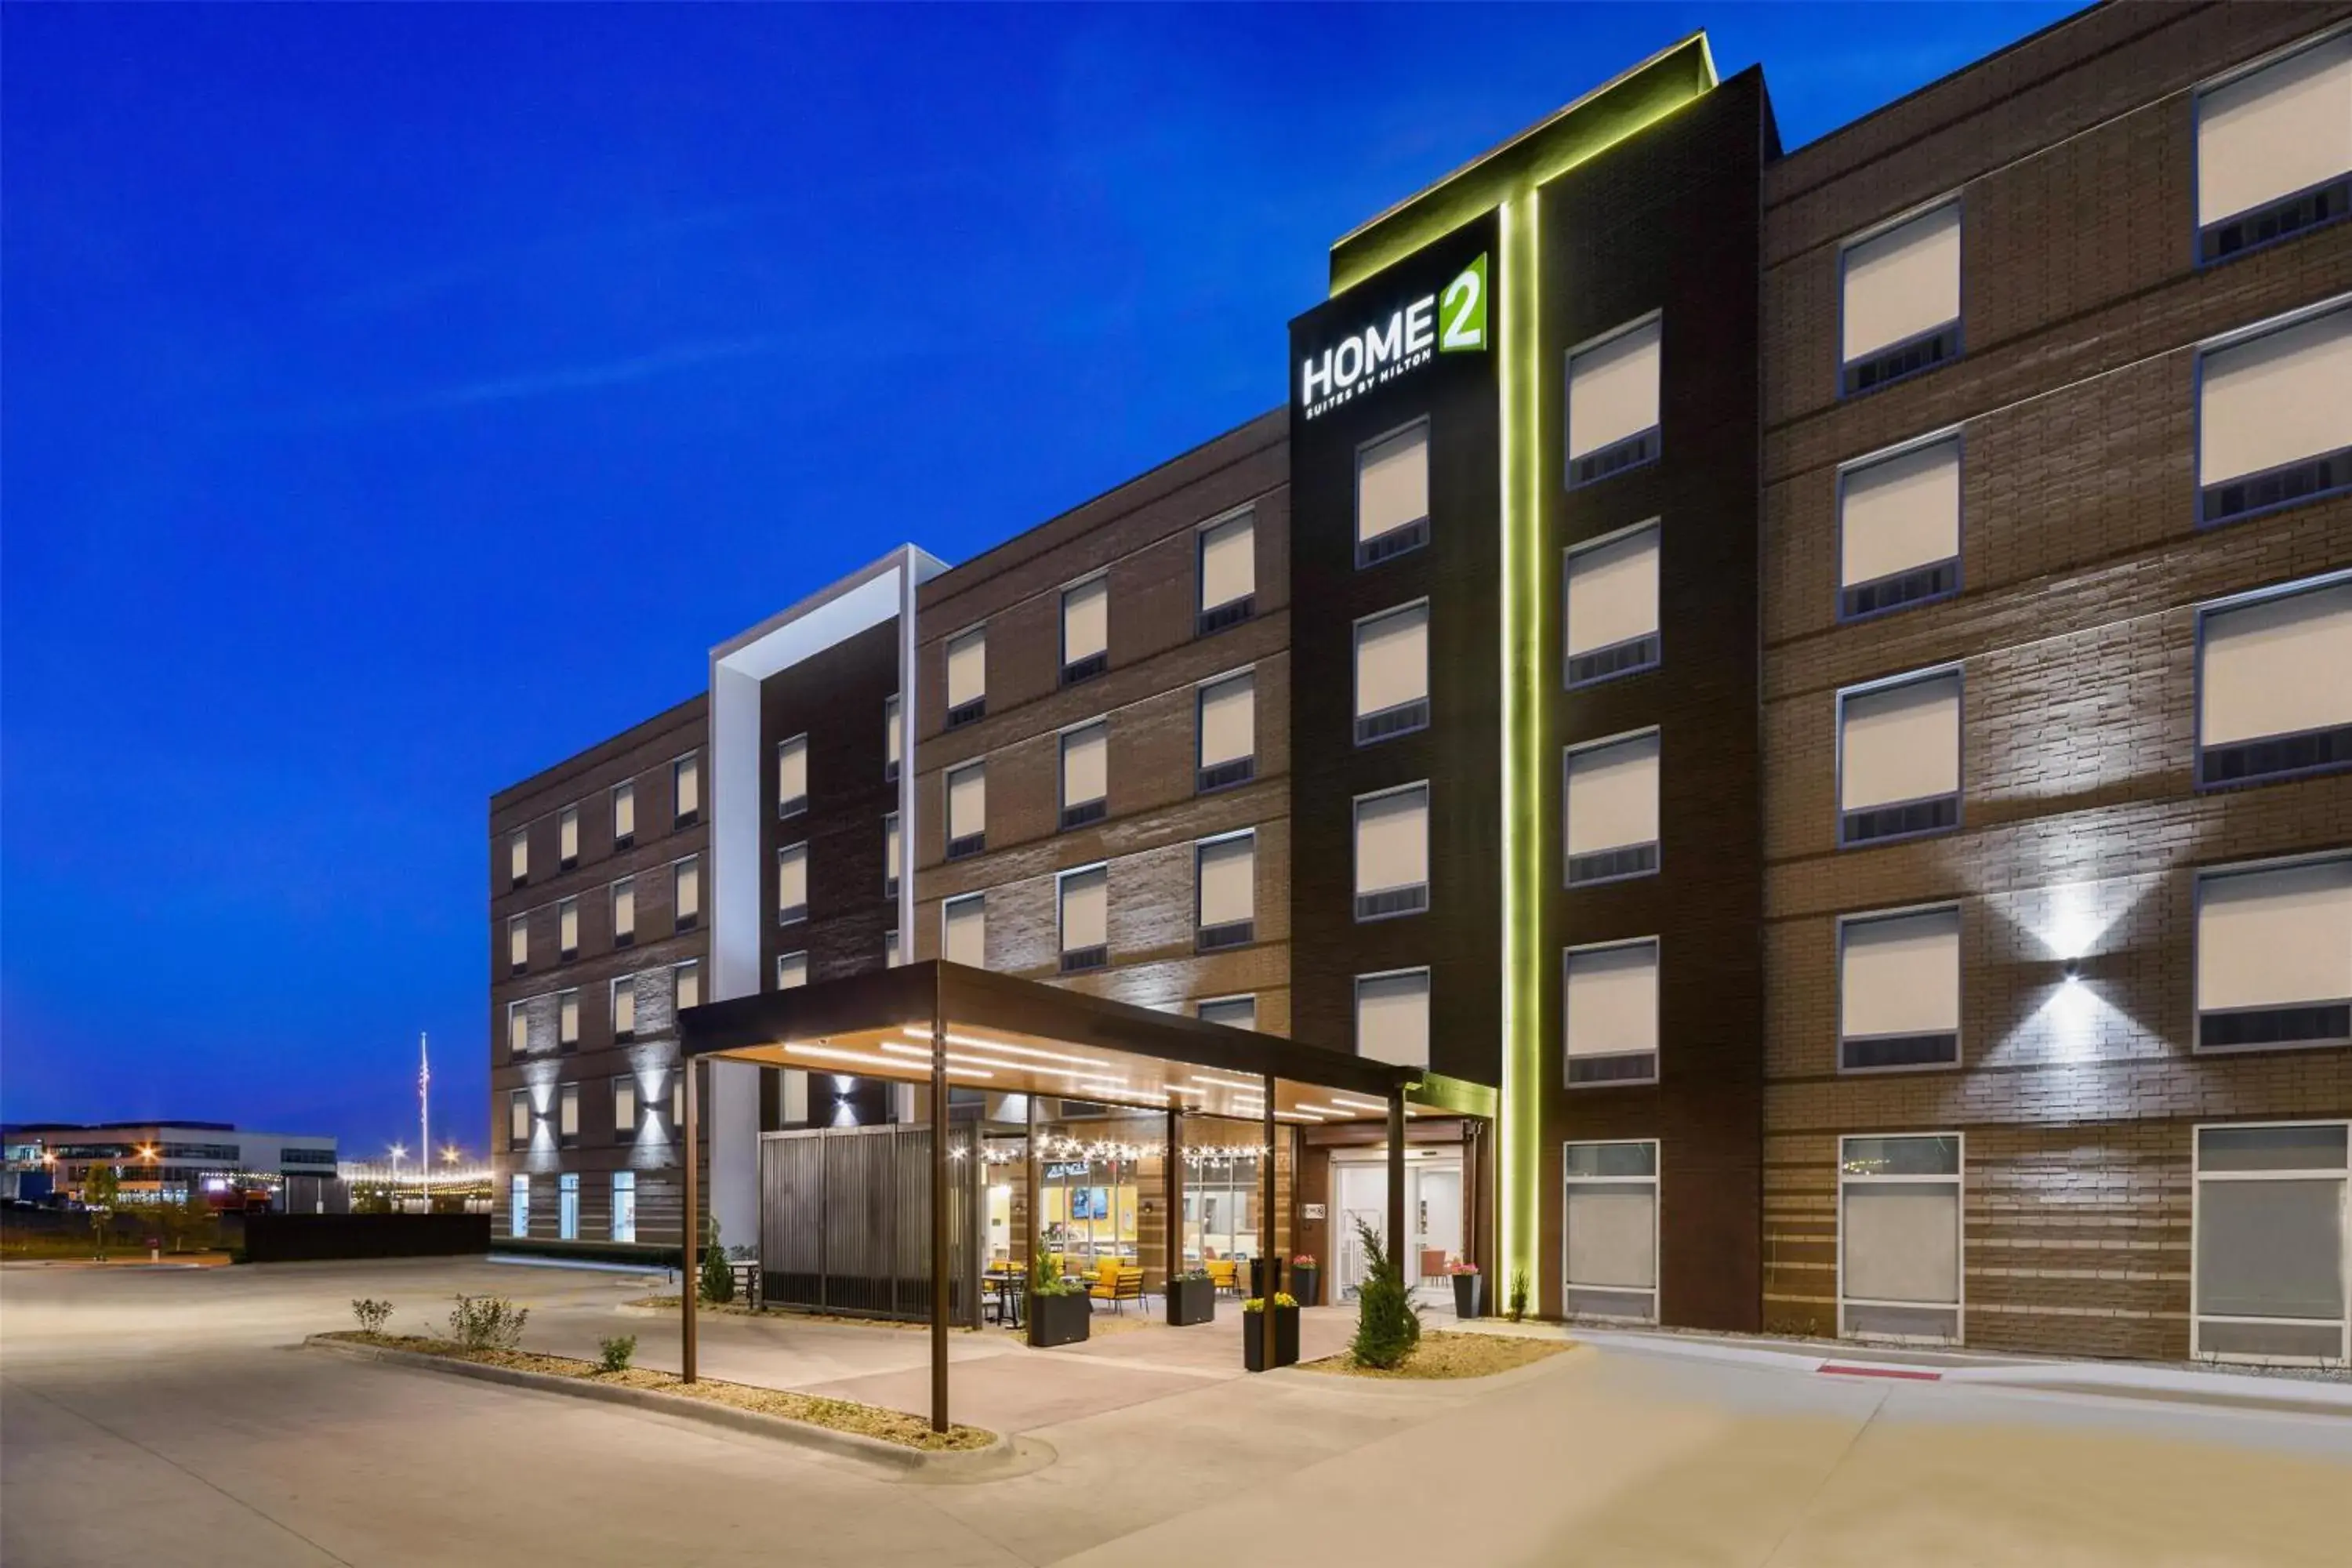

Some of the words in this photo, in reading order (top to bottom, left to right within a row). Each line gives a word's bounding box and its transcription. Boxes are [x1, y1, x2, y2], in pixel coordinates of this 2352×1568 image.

[1302, 293, 1435, 407] HOME
[1443, 270, 1481, 348] 2
[1306, 388, 1352, 420] SUITES
[1357, 376, 1375, 394] BY
[1380, 348, 1432, 383] HILTON
